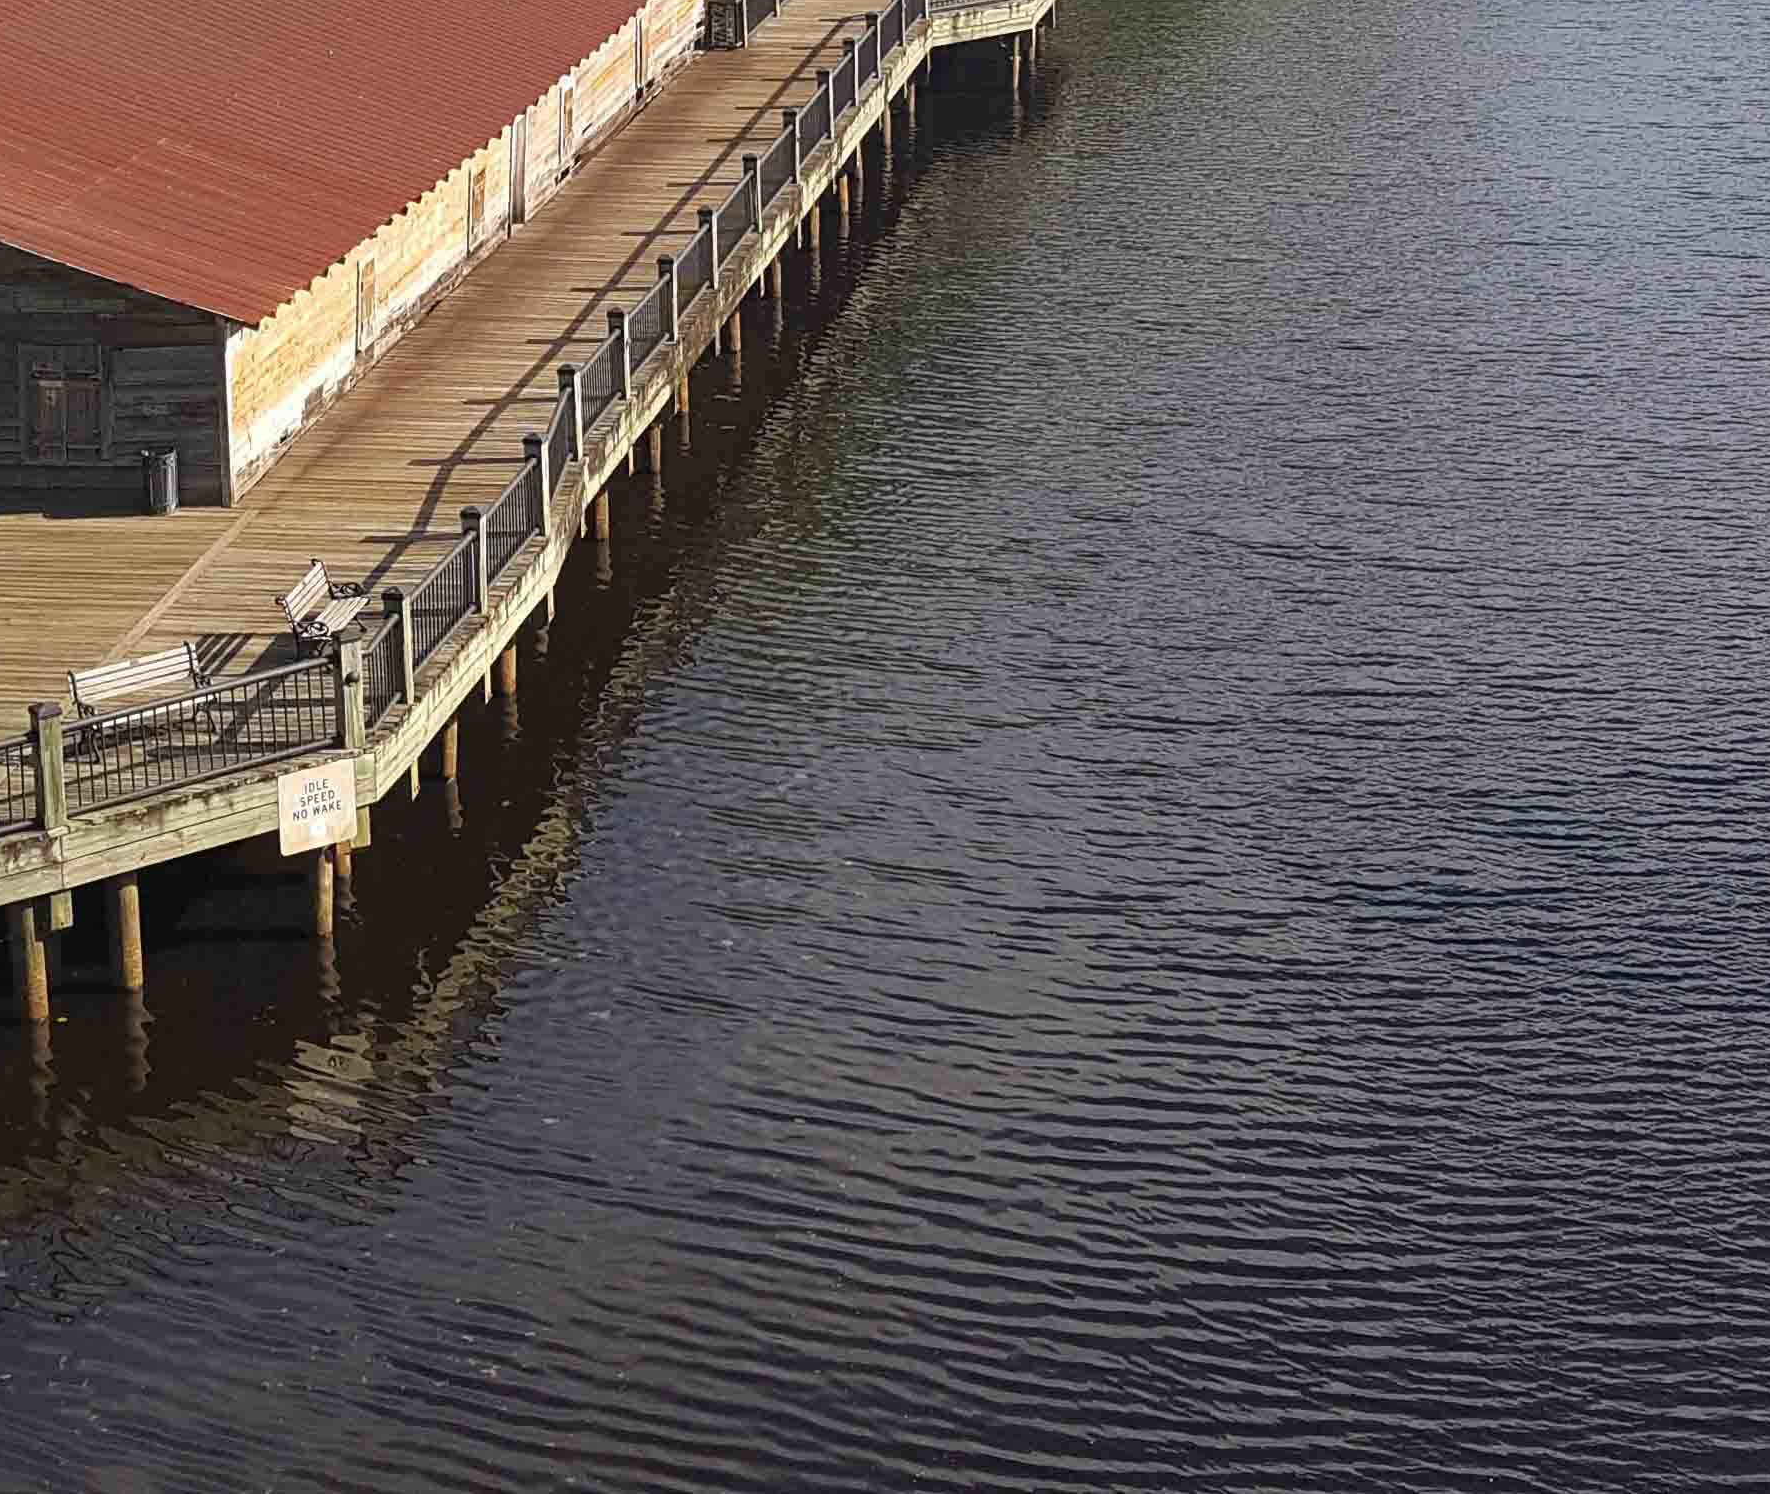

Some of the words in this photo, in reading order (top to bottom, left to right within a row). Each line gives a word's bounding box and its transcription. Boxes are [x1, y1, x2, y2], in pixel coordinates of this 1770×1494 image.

[300, 789, 335, 807] SPEED
[293, 809, 308, 821] NO
[312, 800, 341, 816] WAKE
